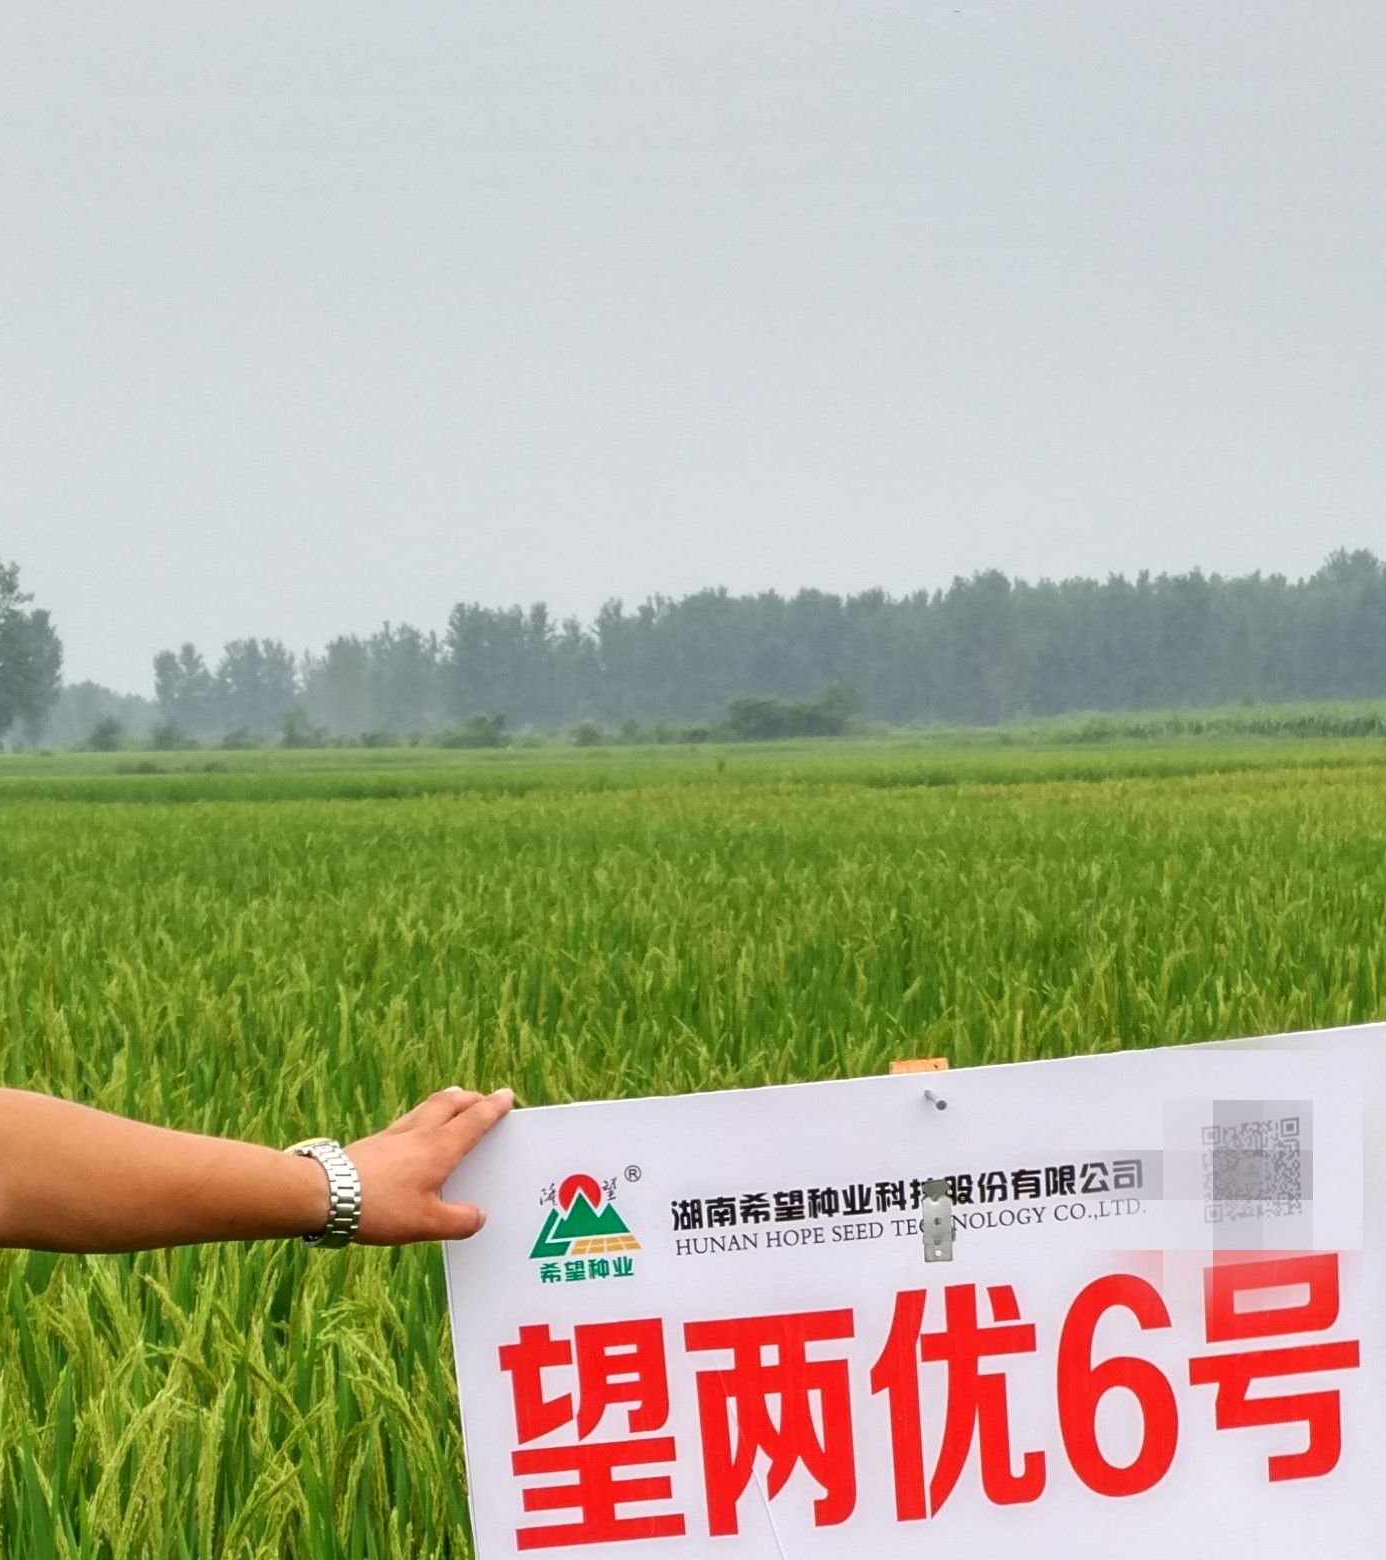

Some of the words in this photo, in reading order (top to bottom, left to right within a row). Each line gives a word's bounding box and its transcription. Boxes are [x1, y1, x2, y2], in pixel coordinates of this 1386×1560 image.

[675, 1233, 758, 1256] HUNAN
[766, 1227, 826, 1248] HOPE
[832, 1221, 884, 1243] SEED
[891, 1206, 1047, 1237] TENOLOGY
[539, 1256, 635, 1284] 希望种业
[497, 1252, 1362, 1551] 望两优6号
